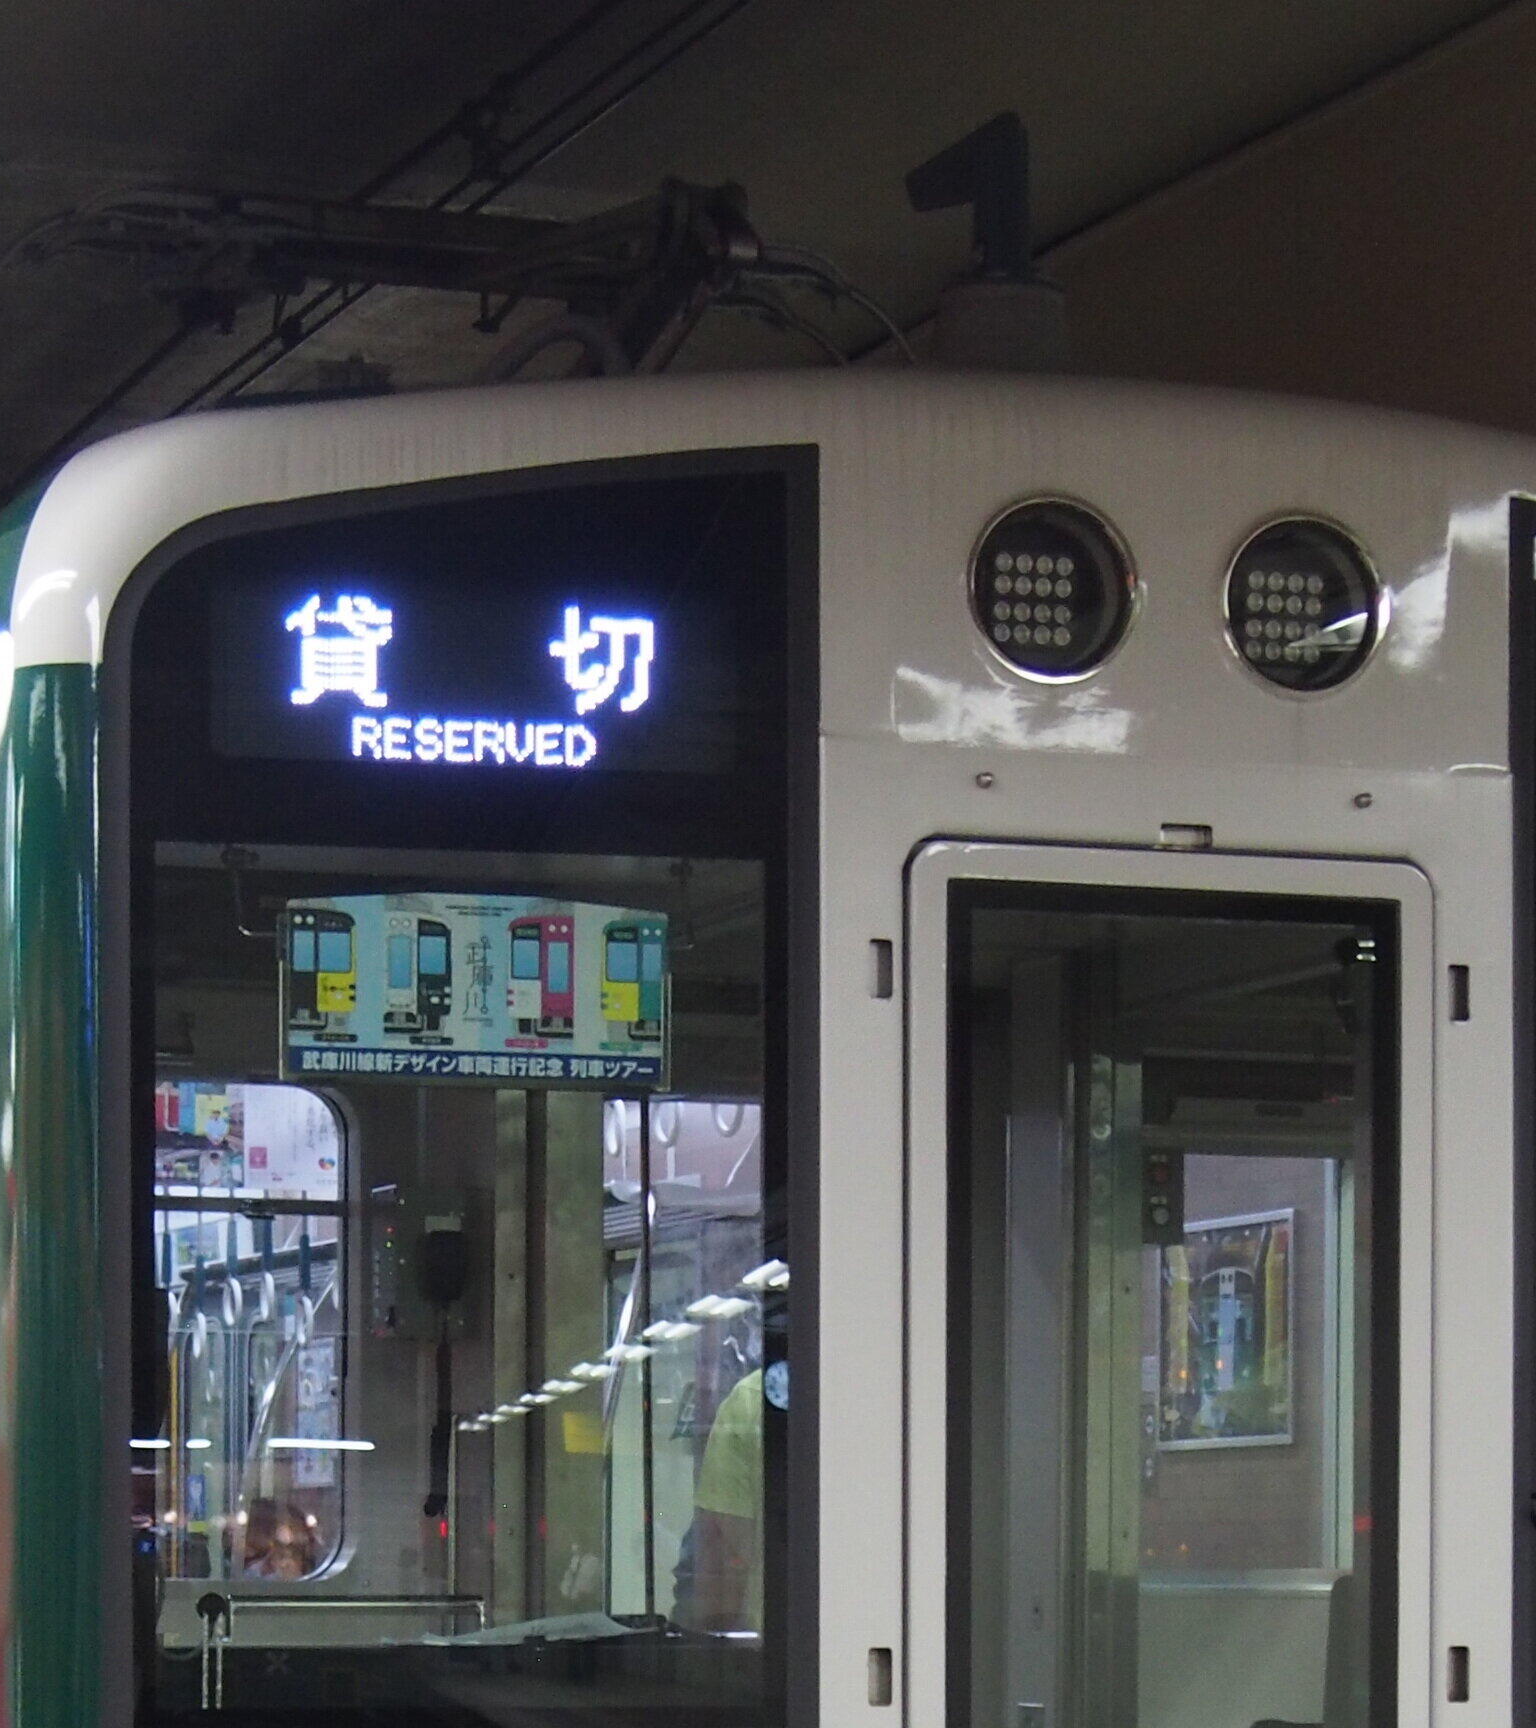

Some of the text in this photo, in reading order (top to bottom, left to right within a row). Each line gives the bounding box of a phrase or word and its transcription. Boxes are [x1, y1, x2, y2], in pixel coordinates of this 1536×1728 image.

[285, 595, 654, 715] 貸 切
[352, 716, 596, 767] RESERVED
[569, 1063, 655, 1080] 列車ツアー
